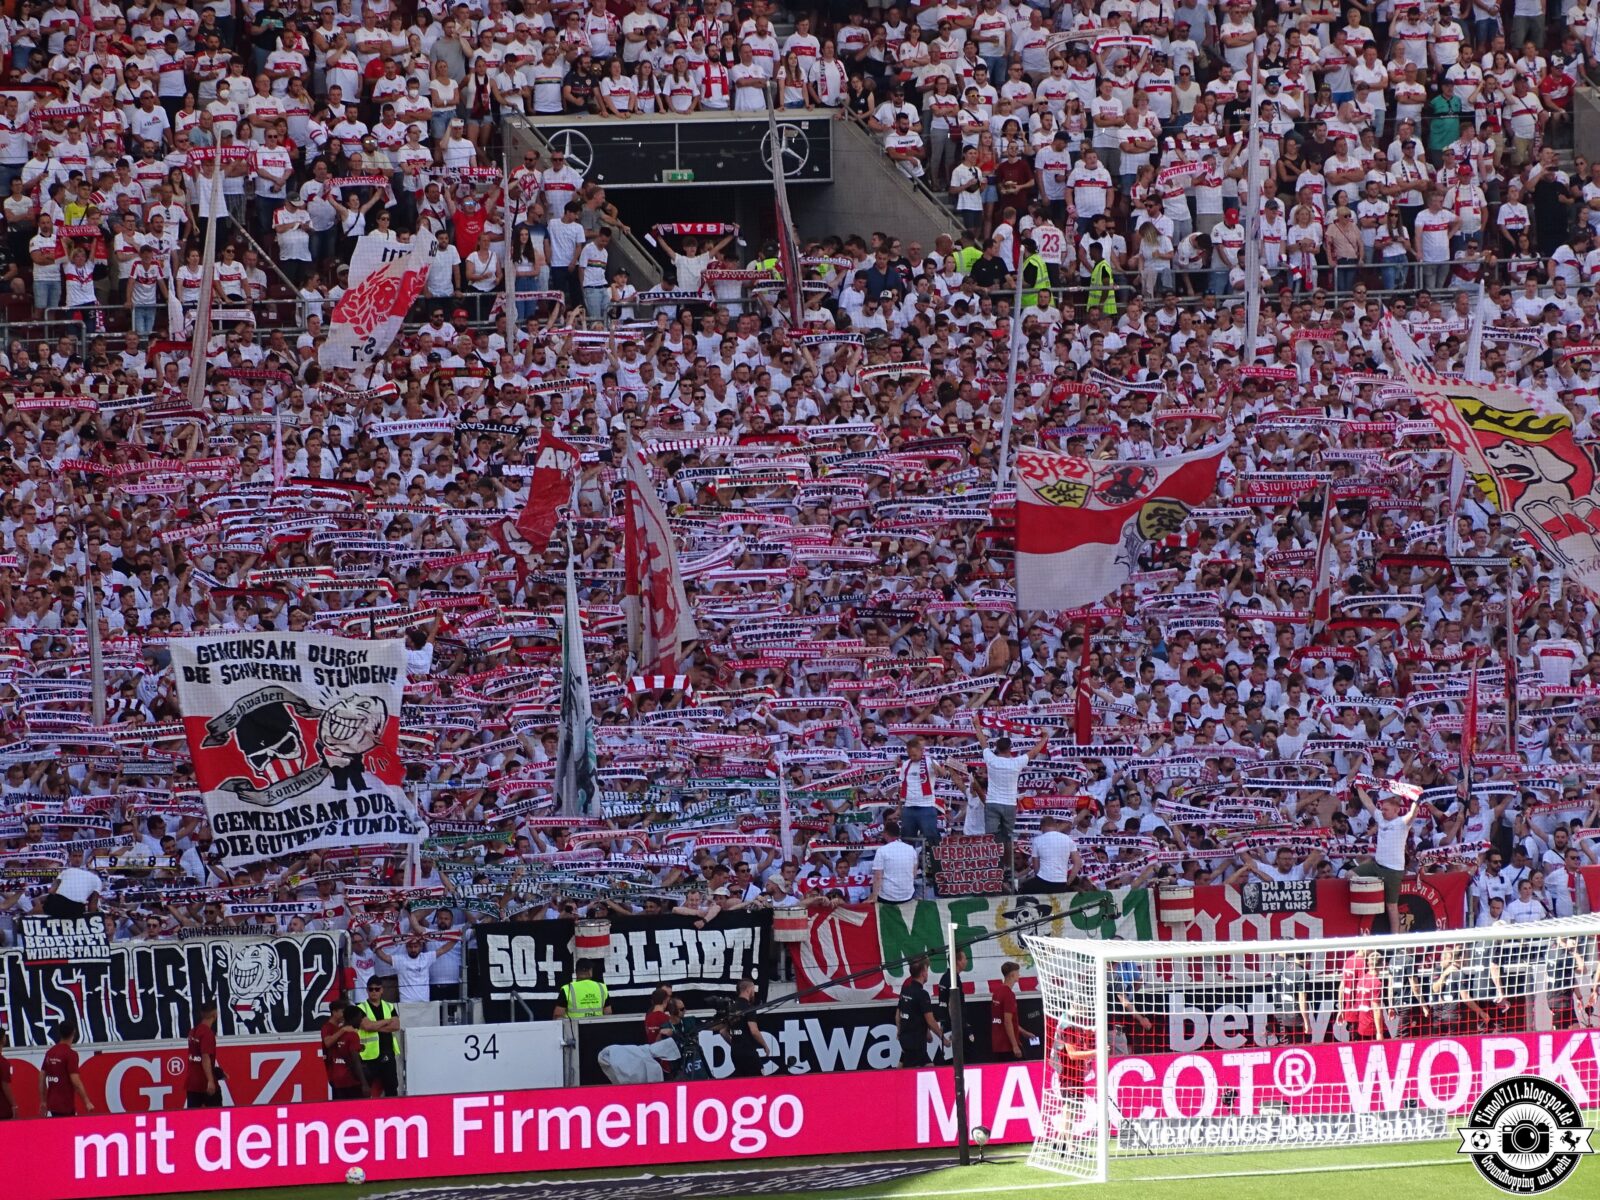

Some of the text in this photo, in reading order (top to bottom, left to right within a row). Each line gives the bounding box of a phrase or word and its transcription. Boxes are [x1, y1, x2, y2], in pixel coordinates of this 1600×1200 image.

[208, 147, 250, 160] STTTGART
[682, 224, 717, 234] VfB
[1042, 234, 1059, 252] 23
[667, 518, 708, 528] TTGART
[746, 543, 785, 551] TTGART
[197, 640, 368, 664] GEMEINSAM DURCH
[184, 662, 398, 688] DIE SCHWEREN STUNDEN!
[224, 691, 285, 724] Schwaben
[1061, 746, 1134, 757] COMMANDO
[1160, 765, 1202, 779] 1893
[213, 794, 398, 833] GEMEINSAM DUR
[215, 836, 252, 858] DIE
[254, 824, 323, 852] GUTEN
[940, 834, 995, 846] JEDER
[1078, 837, 1142, 846] STUTTGART
[932, 843, 1004, 860] VERBANNTE
[941, 857, 1000, 871] KEHRT
[1261, 879, 1312, 891] DU BIST
[1261, 889, 1313, 902] IMMER
[230, 903, 304, 914] STUTTGART
[1261, 899, 1314, 911] BEI UNS!
[22, 916, 105, 936] ULTRAS
[24, 933, 107, 948] BEDEUTET
[880, 897, 990, 980] MF
[26, 945, 111, 960] WIDERSTAND
[603, 926, 762, 986] BLEIBT!
[271, 930, 340, 1035] 02
[464, 1034, 500, 1061] 34
[1338, 1030, 1600, 1112] WORK
[74, 1085, 804, 1180] mit deinem Firmenlogo
